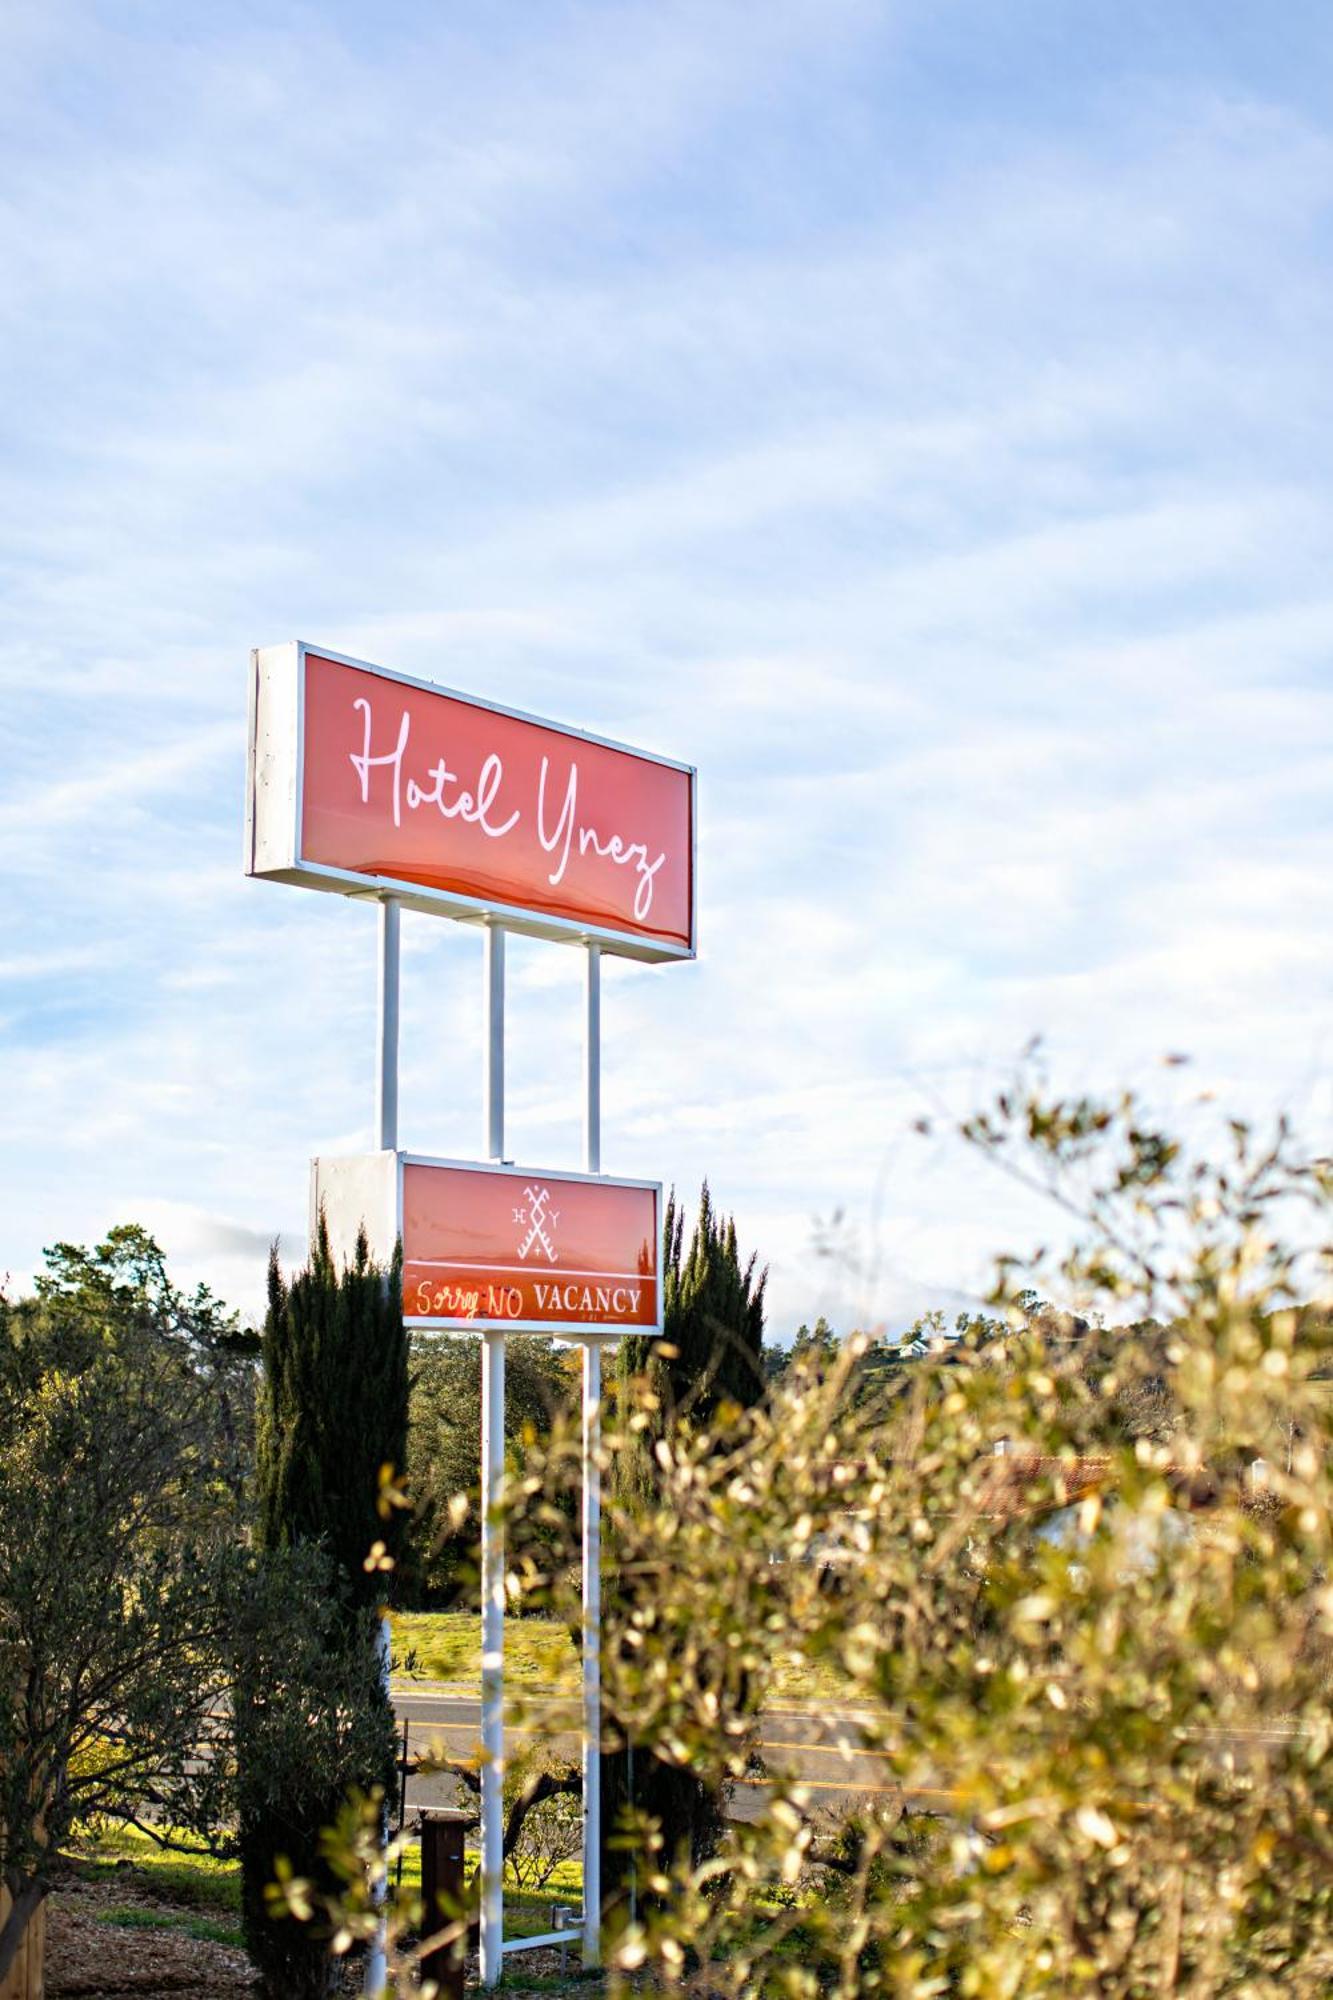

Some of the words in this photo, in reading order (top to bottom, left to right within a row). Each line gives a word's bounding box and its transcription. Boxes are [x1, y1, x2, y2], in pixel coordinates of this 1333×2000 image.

[350, 698, 520, 837] Hotel
[537, 756, 666, 920] Ynez
[512, 1209, 526, 1223] H
[549, 1211, 560, 1228] Y
[416, 1281, 479, 1320] Sorry
[488, 1285, 523, 1318] NO
[533, 1284, 642, 1313] VACANCY
